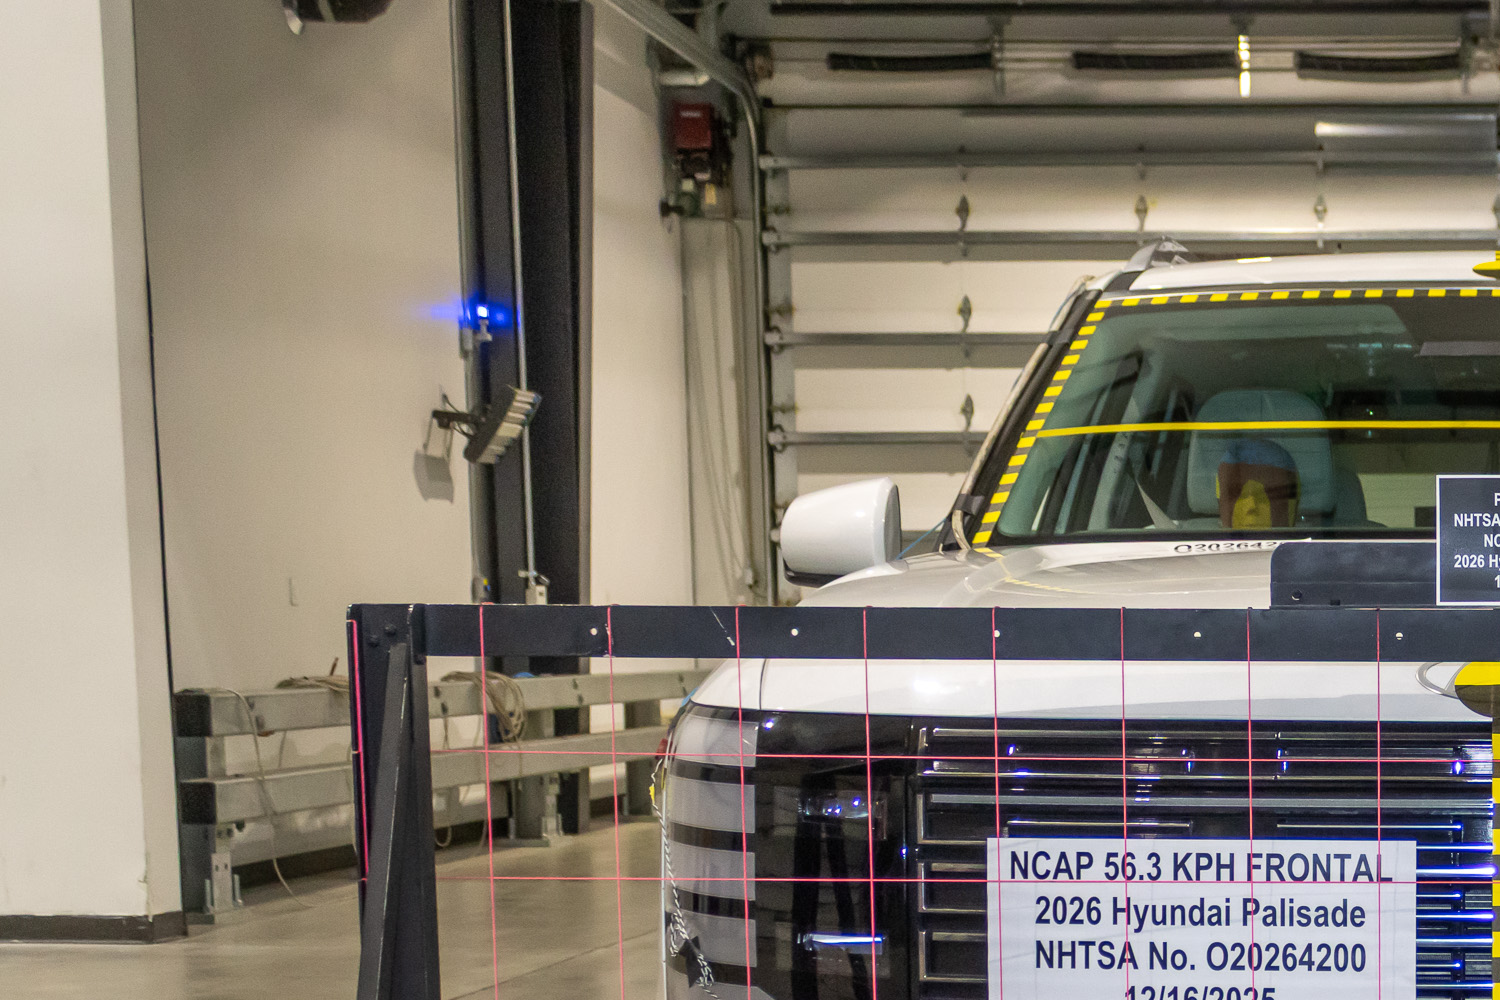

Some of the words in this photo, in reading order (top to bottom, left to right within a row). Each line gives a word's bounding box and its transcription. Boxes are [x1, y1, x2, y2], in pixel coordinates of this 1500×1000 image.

[1454, 513, 1500, 527] NHTSA
[1454, 554, 1485, 568] 2026
[1010, 850, 1094, 880] NCAP
[1104, 852, 1162, 881] 56.3
[1173, 852, 1234, 882] KPH
[1247, 852, 1393, 883] FRONTAL
[1036, 896, 1102, 925] 2026
[1112, 897, 1230, 933] Hyundai
[1242, 898, 1366, 927] Palisade
[1036, 940, 1138, 970] NHTSA
[1149, 942, 1196, 971] No.
